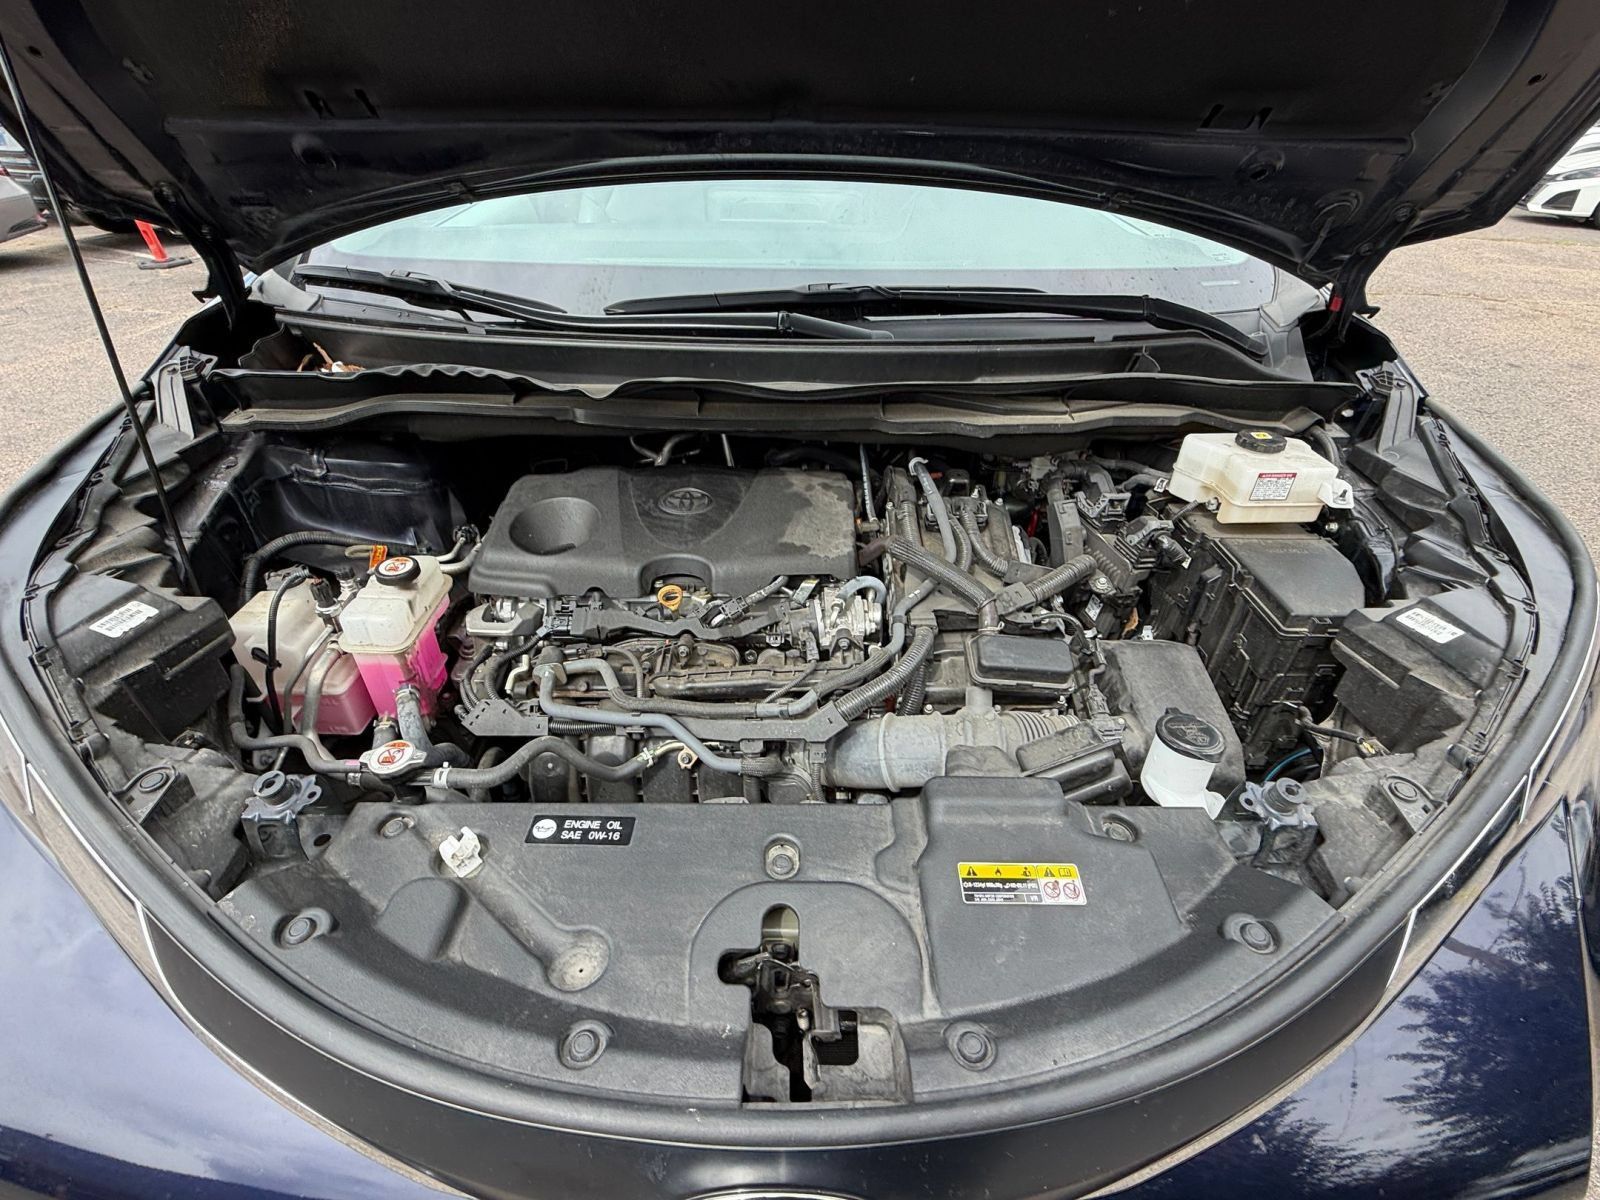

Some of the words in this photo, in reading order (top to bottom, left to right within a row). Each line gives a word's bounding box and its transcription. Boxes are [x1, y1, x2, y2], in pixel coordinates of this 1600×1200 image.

[563, 819, 601, 829] ENGINE
[606, 820, 623, 830] OIL
[560, 830, 582, 840] SAE
[588, 831, 621, 841] 0W-16
